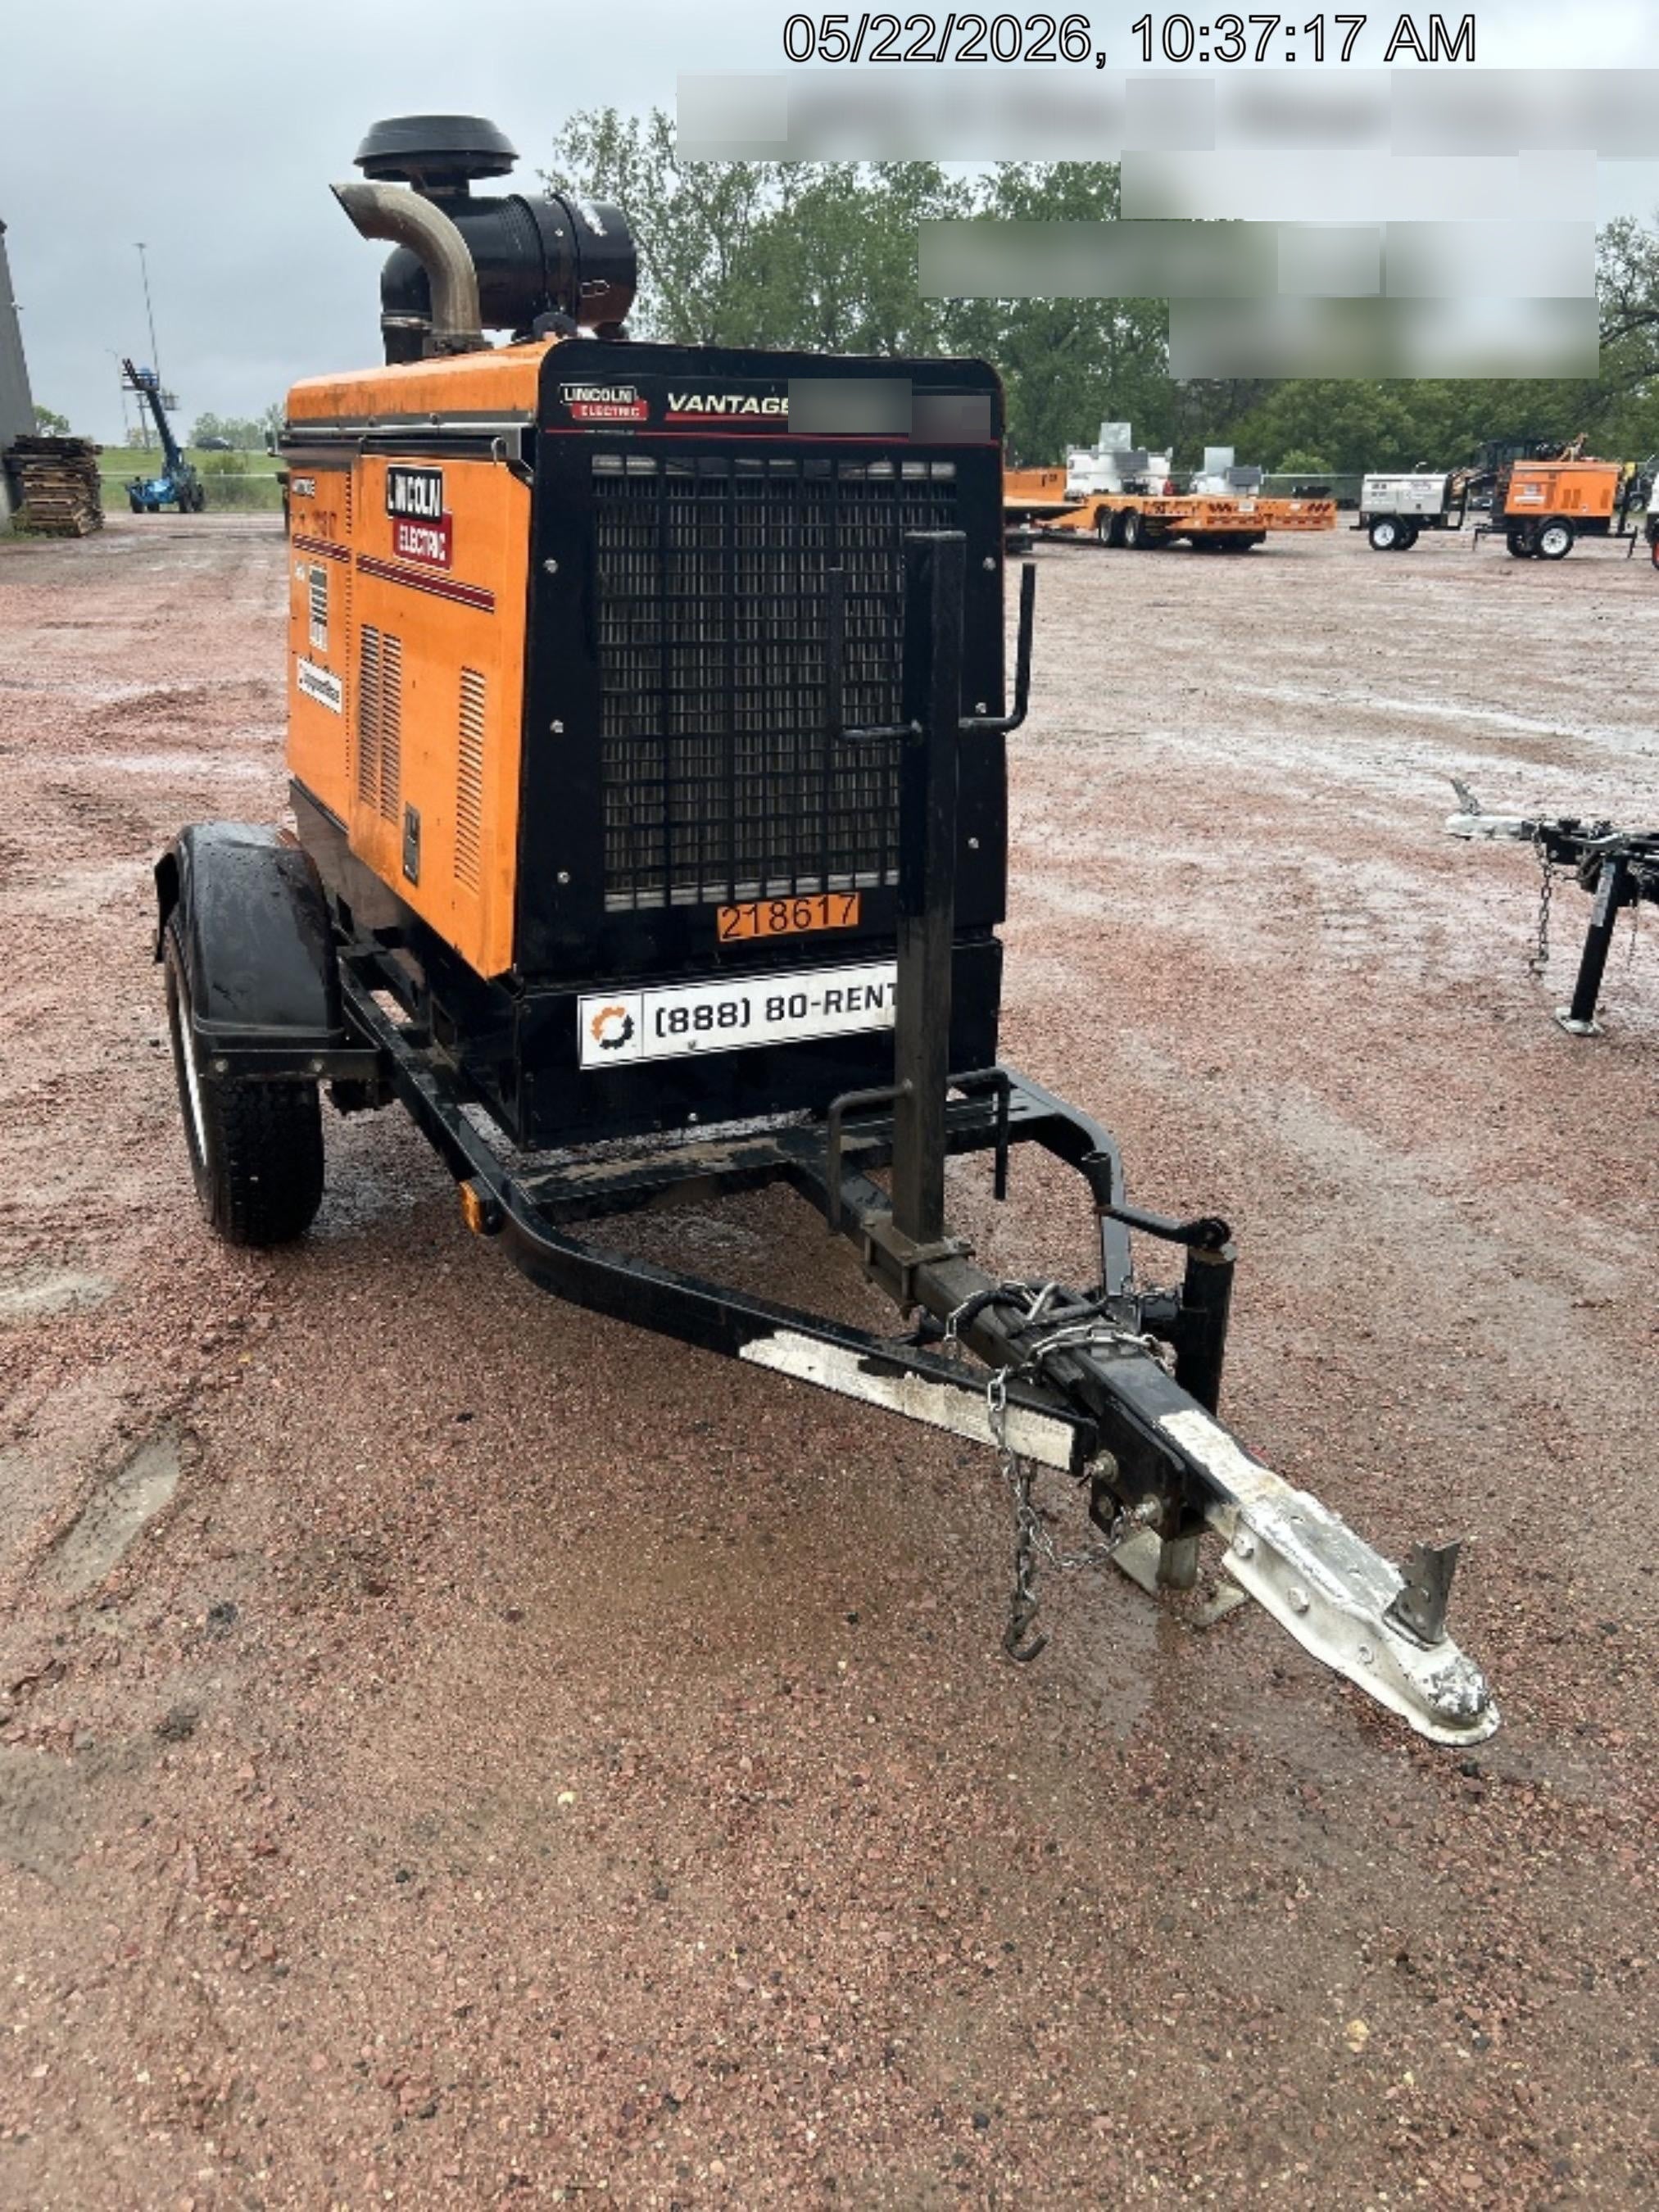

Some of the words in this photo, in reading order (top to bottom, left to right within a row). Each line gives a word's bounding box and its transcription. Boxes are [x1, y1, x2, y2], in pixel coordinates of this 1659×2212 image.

[563, 387, 633, 404] LINCOLN
[387, 473, 441, 517] LINCOLN
[720, 894, 857, 939] 218617
[655, 997, 751, 1038] (888)
